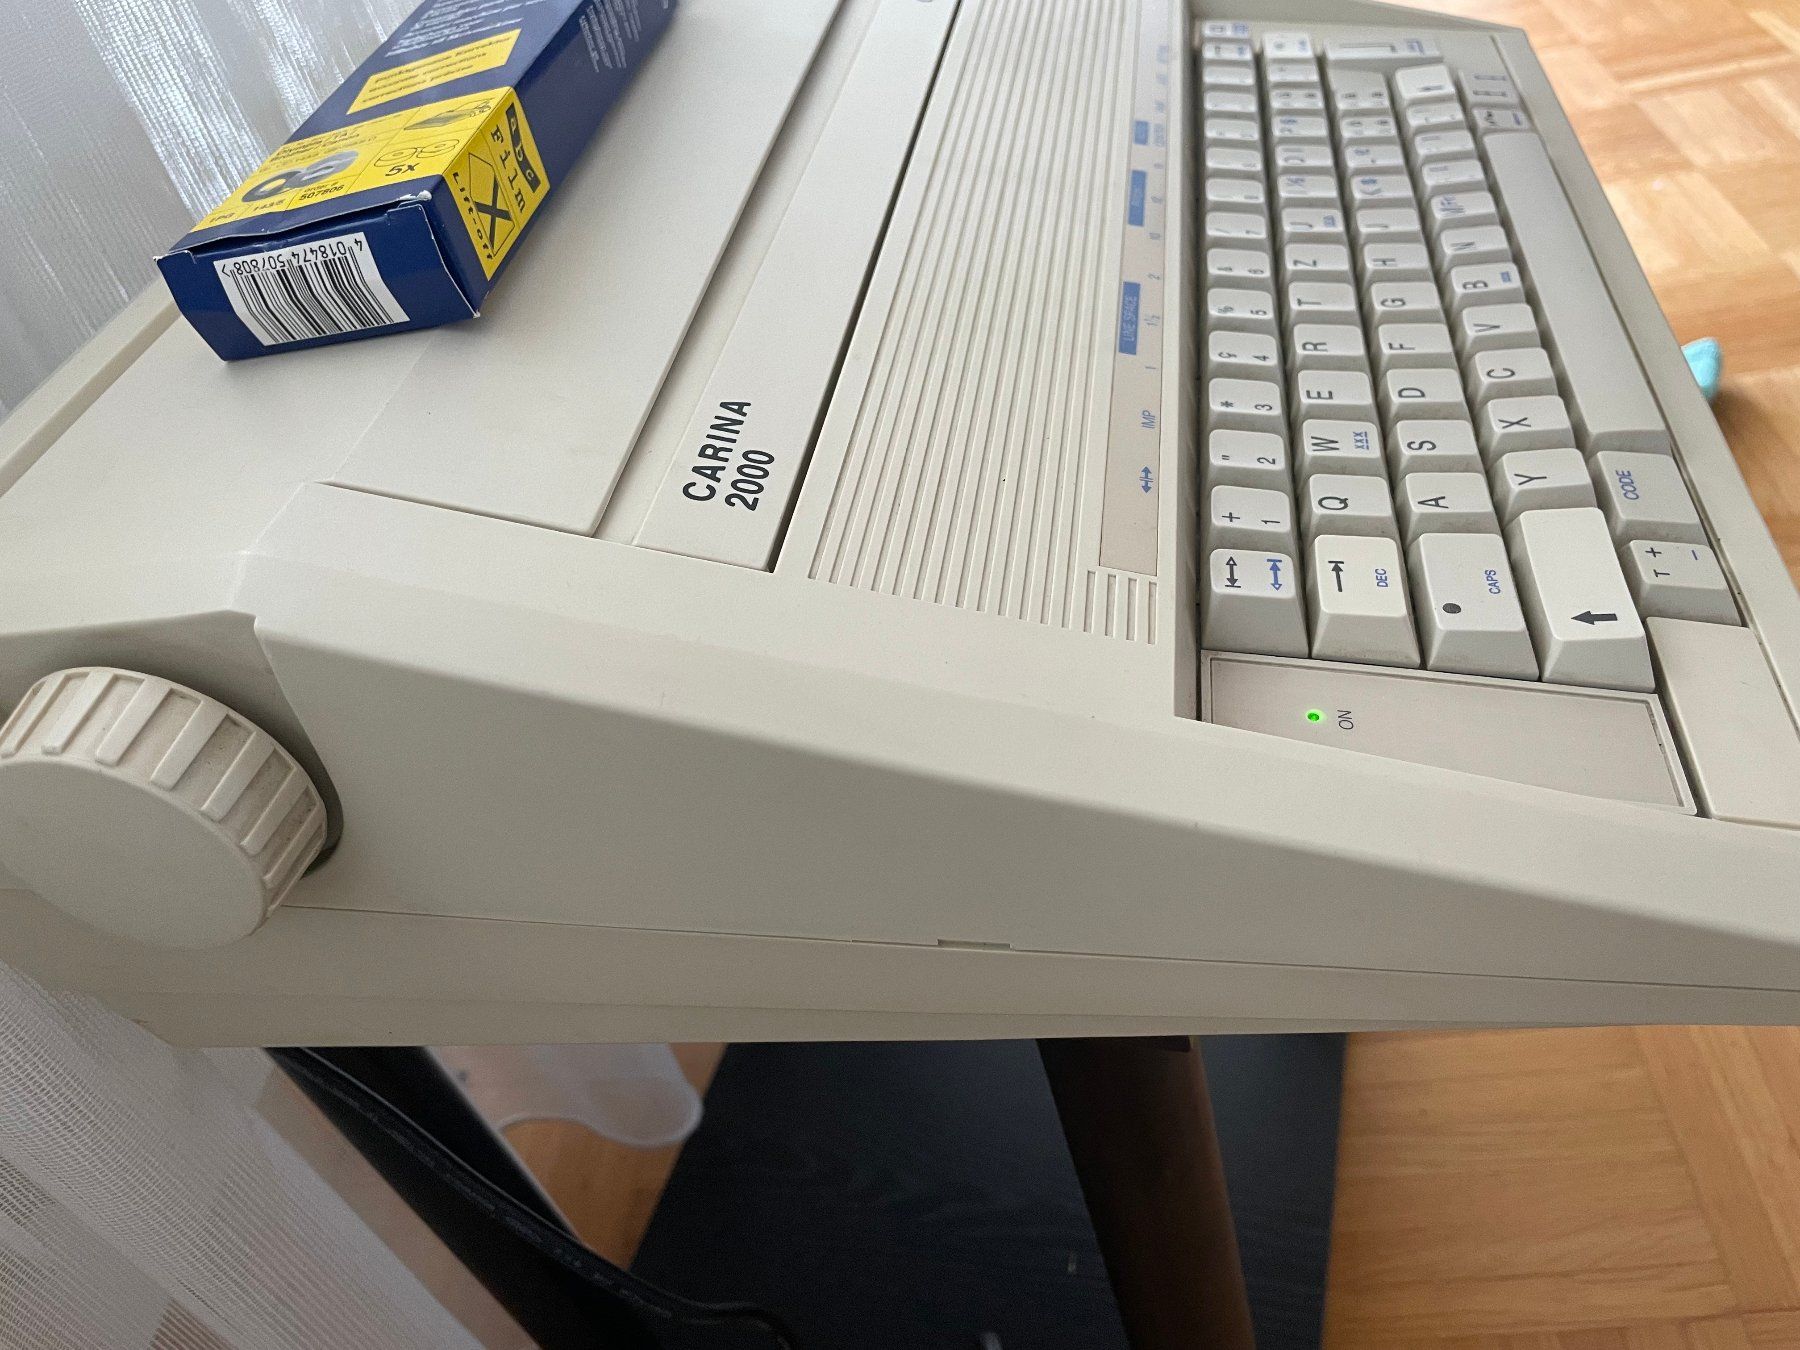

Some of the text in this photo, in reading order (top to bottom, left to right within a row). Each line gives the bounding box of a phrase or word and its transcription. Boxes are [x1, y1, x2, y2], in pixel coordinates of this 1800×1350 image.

[491, 124, 526, 213] Film
[291, 241, 346, 264] 018474
[1293, 259, 1317, 267] Z
[1372, 258, 1396, 266] H
[1463, 280, 1488, 290] B
[1297, 298, 1321, 306] T
[1381, 297, 1406, 308] G
[1473, 322, 1501, 333] V
[1302, 341, 1328, 352] R
[1389, 342, 1415, 351] F
[1252, 353, 1270, 362] 4
[1486, 367, 1516, 380] C
[1306, 389, 1334, 400] E
[1398, 387, 1426, 398] D
[1254, 403, 1273, 411] 3
[1141, 409, 1156, 429] IMP
[1498, 417, 1532, 429] X
[1311, 436, 1340, 452] W
[1407, 440, 1437, 452] S
[682, 401, 752, 502] CARINA
[1257, 456, 1276, 465] 2
[724, 449, 775, 511] 2000
[1514, 473, 1547, 486] Y
[1615, 469, 1640, 500] CODE
[1318, 496, 1349, 511] Q
[1417, 496, 1449, 509] A
[1374, 568, 1389, 588] DEC
[1484, 569, 1501, 594] CAPS
[1337, 709, 1354, 730] ON
